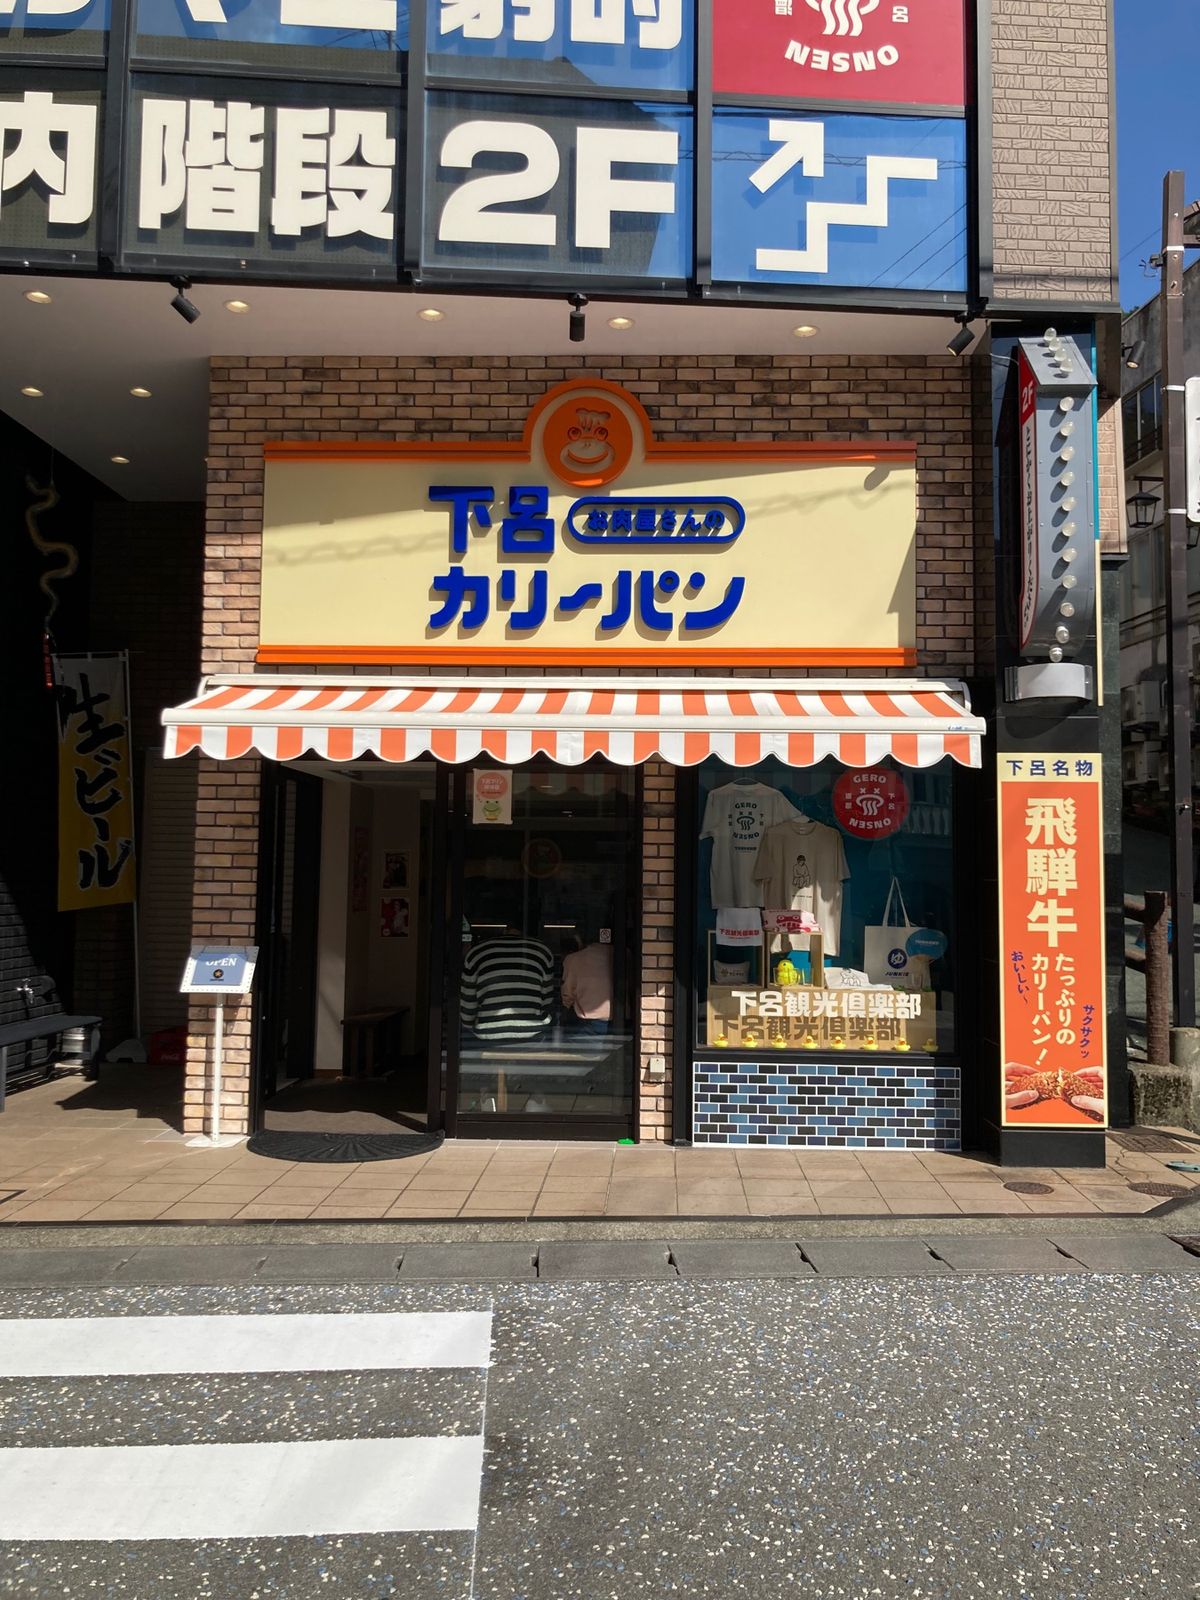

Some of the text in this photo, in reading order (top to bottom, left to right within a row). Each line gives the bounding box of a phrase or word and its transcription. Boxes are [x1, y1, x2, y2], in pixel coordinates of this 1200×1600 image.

[784, 40, 899, 72] ONSEN
[1022, 379, 1035, 415] 2F
[428, 486, 556, 553] 下呂
[586, 508, 726, 533] お肉屋さんの
[429, 566, 746, 630] カリーパン
[74, 672, 134, 891] 生ビール
[852, 773, 887, 784] GERO
[1006, 759, 1094, 777] 下呂名物
[848, 817, 892, 830] ONSEN
[1025, 797, 1078, 948] 飛騨牛
[731, 990, 922, 1020] 下呂観光倶楽部
[1079, 1004, 1095, 1059] サクサクッ
